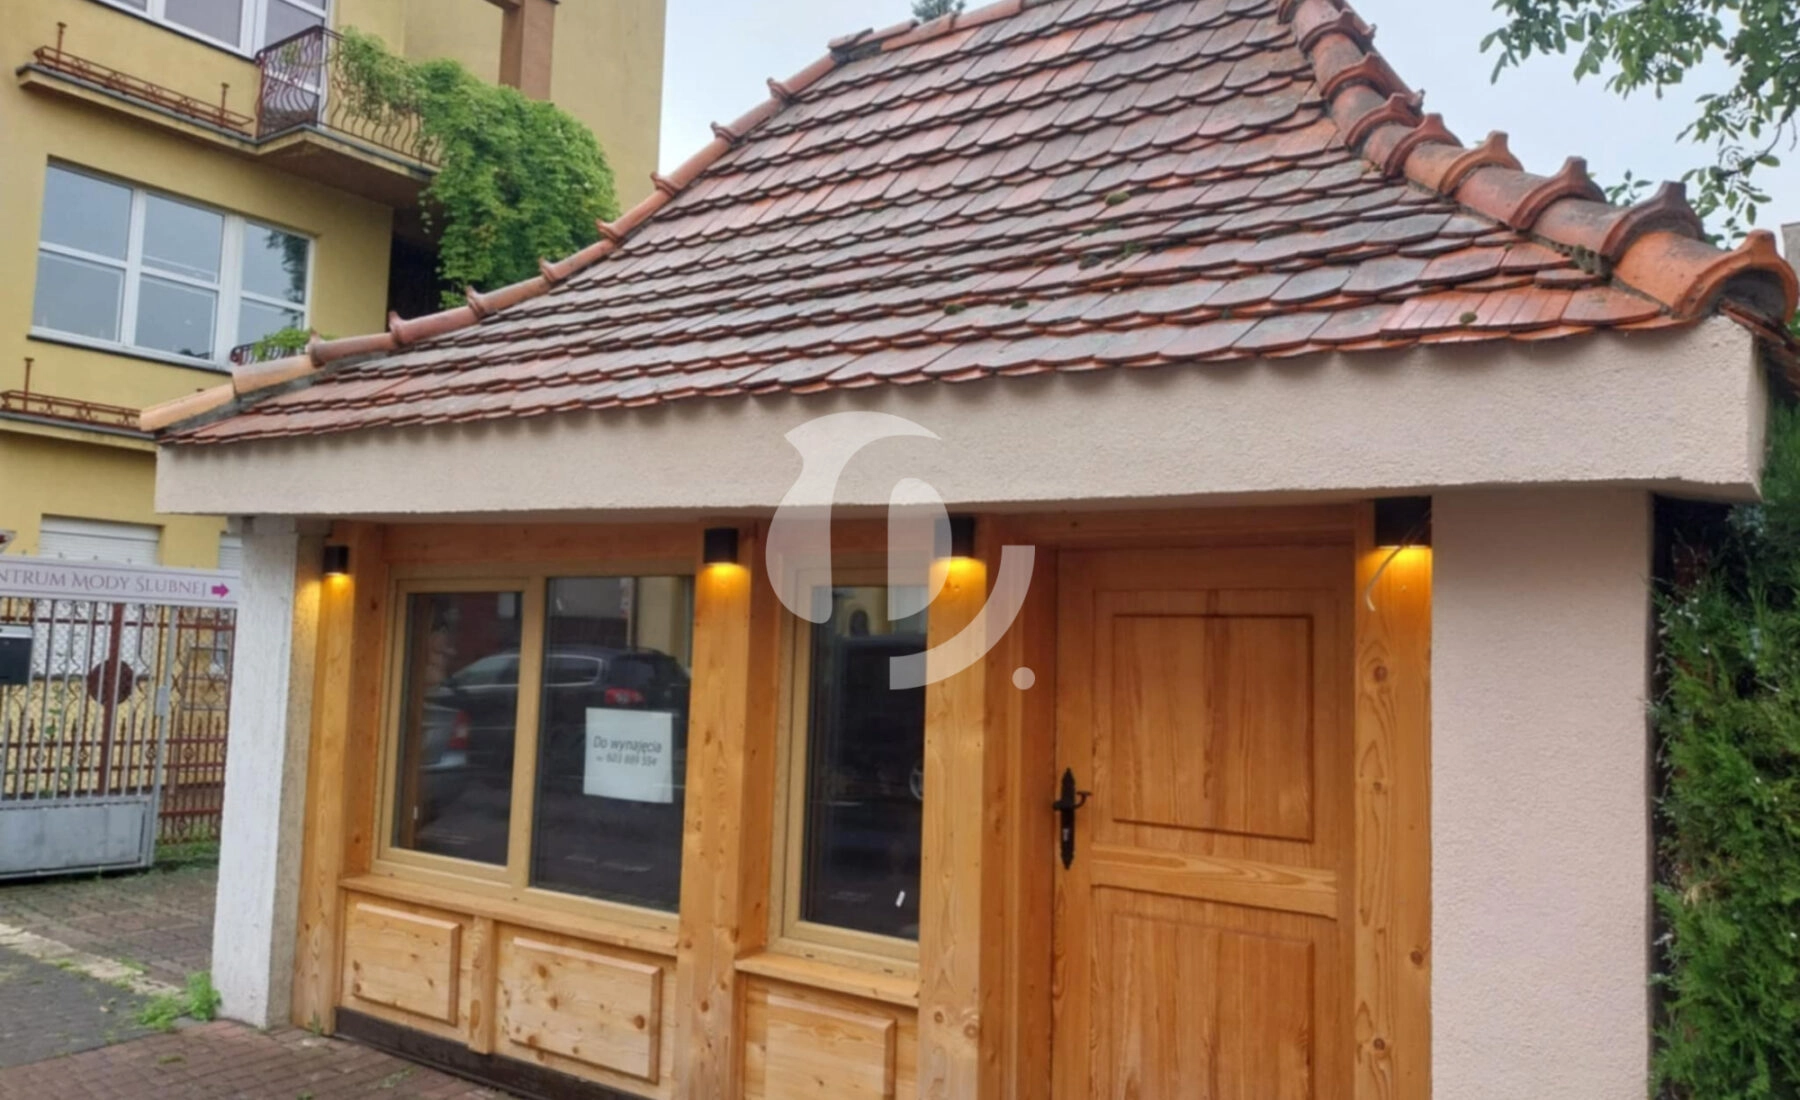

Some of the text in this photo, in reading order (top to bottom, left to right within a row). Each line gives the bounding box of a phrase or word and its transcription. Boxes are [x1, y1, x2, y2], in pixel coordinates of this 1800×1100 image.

[71, 572, 130, 592] MODY
[593, 735, 662, 754] Do wynajęcia
